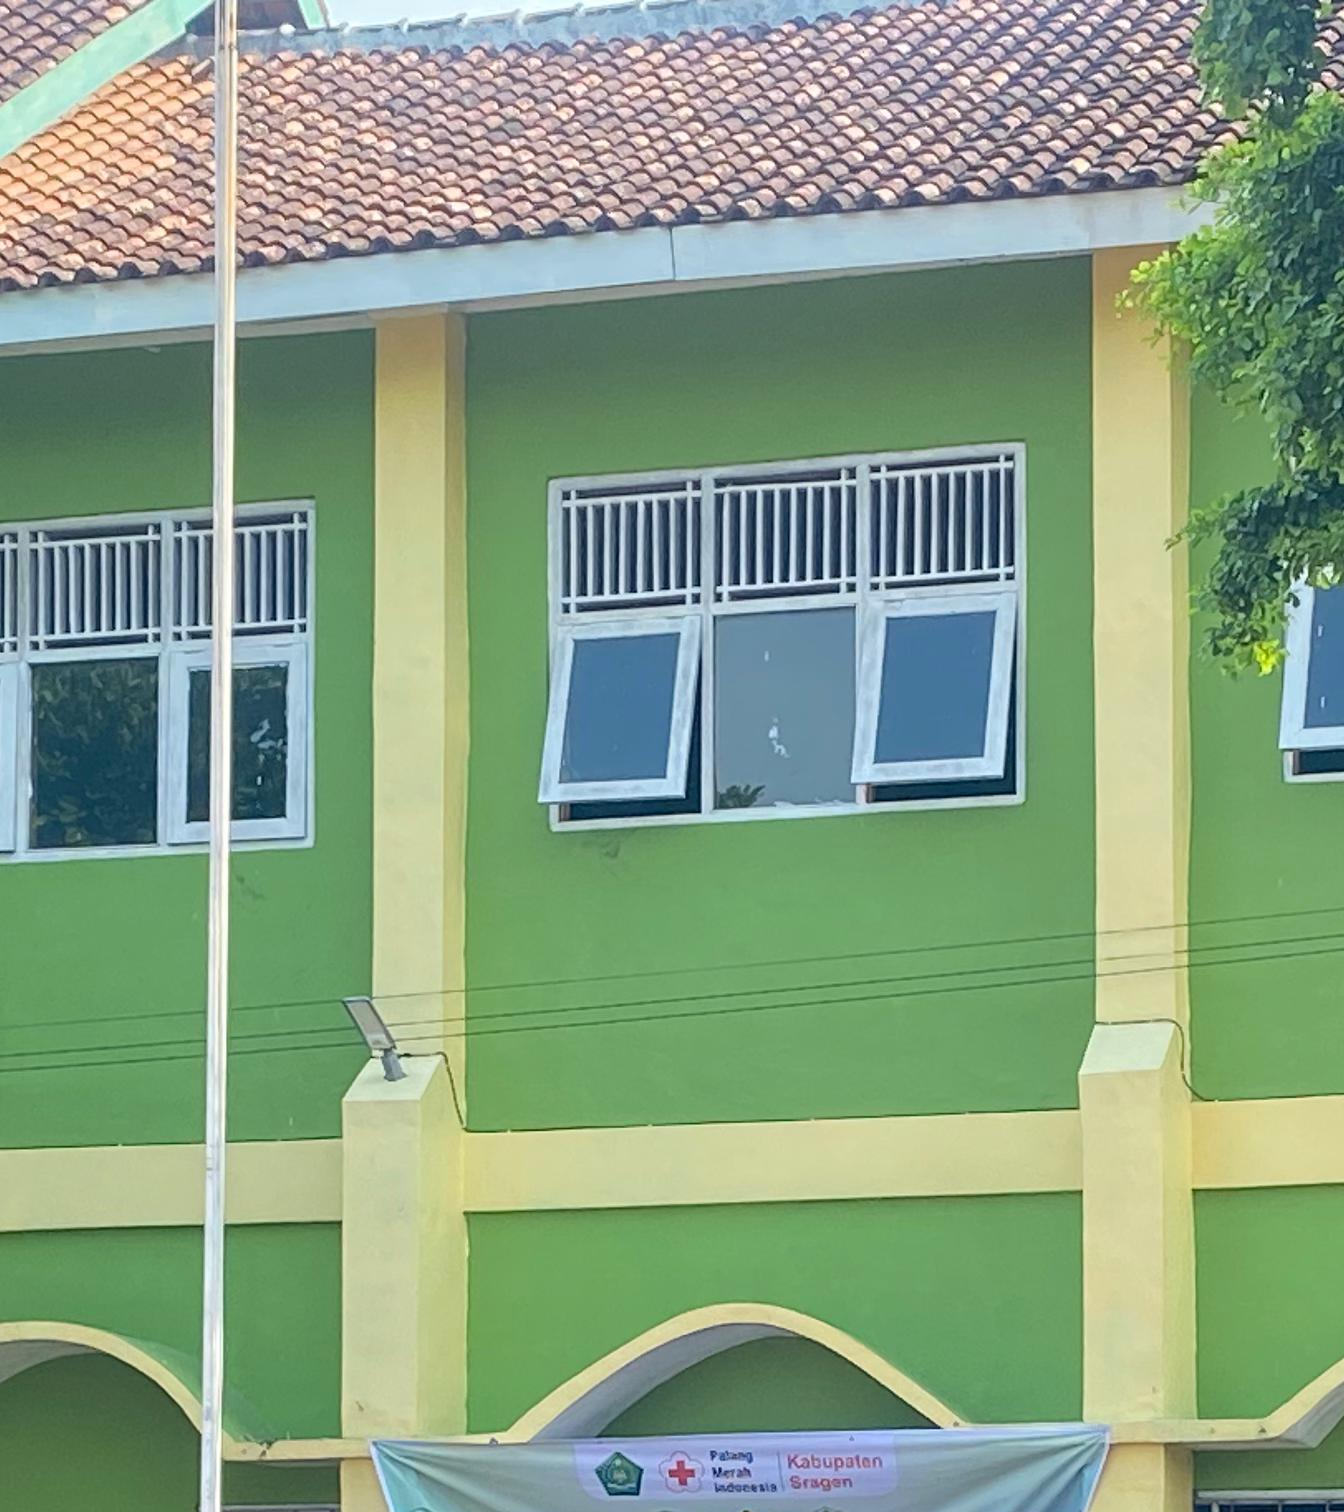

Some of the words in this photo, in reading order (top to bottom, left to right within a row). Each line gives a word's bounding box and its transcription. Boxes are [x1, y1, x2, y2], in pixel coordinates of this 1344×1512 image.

[787, 1453, 883, 1470] Kabupaten
[711, 1467, 752, 1479] Merah
[789, 1476, 853, 1492] Sragen
